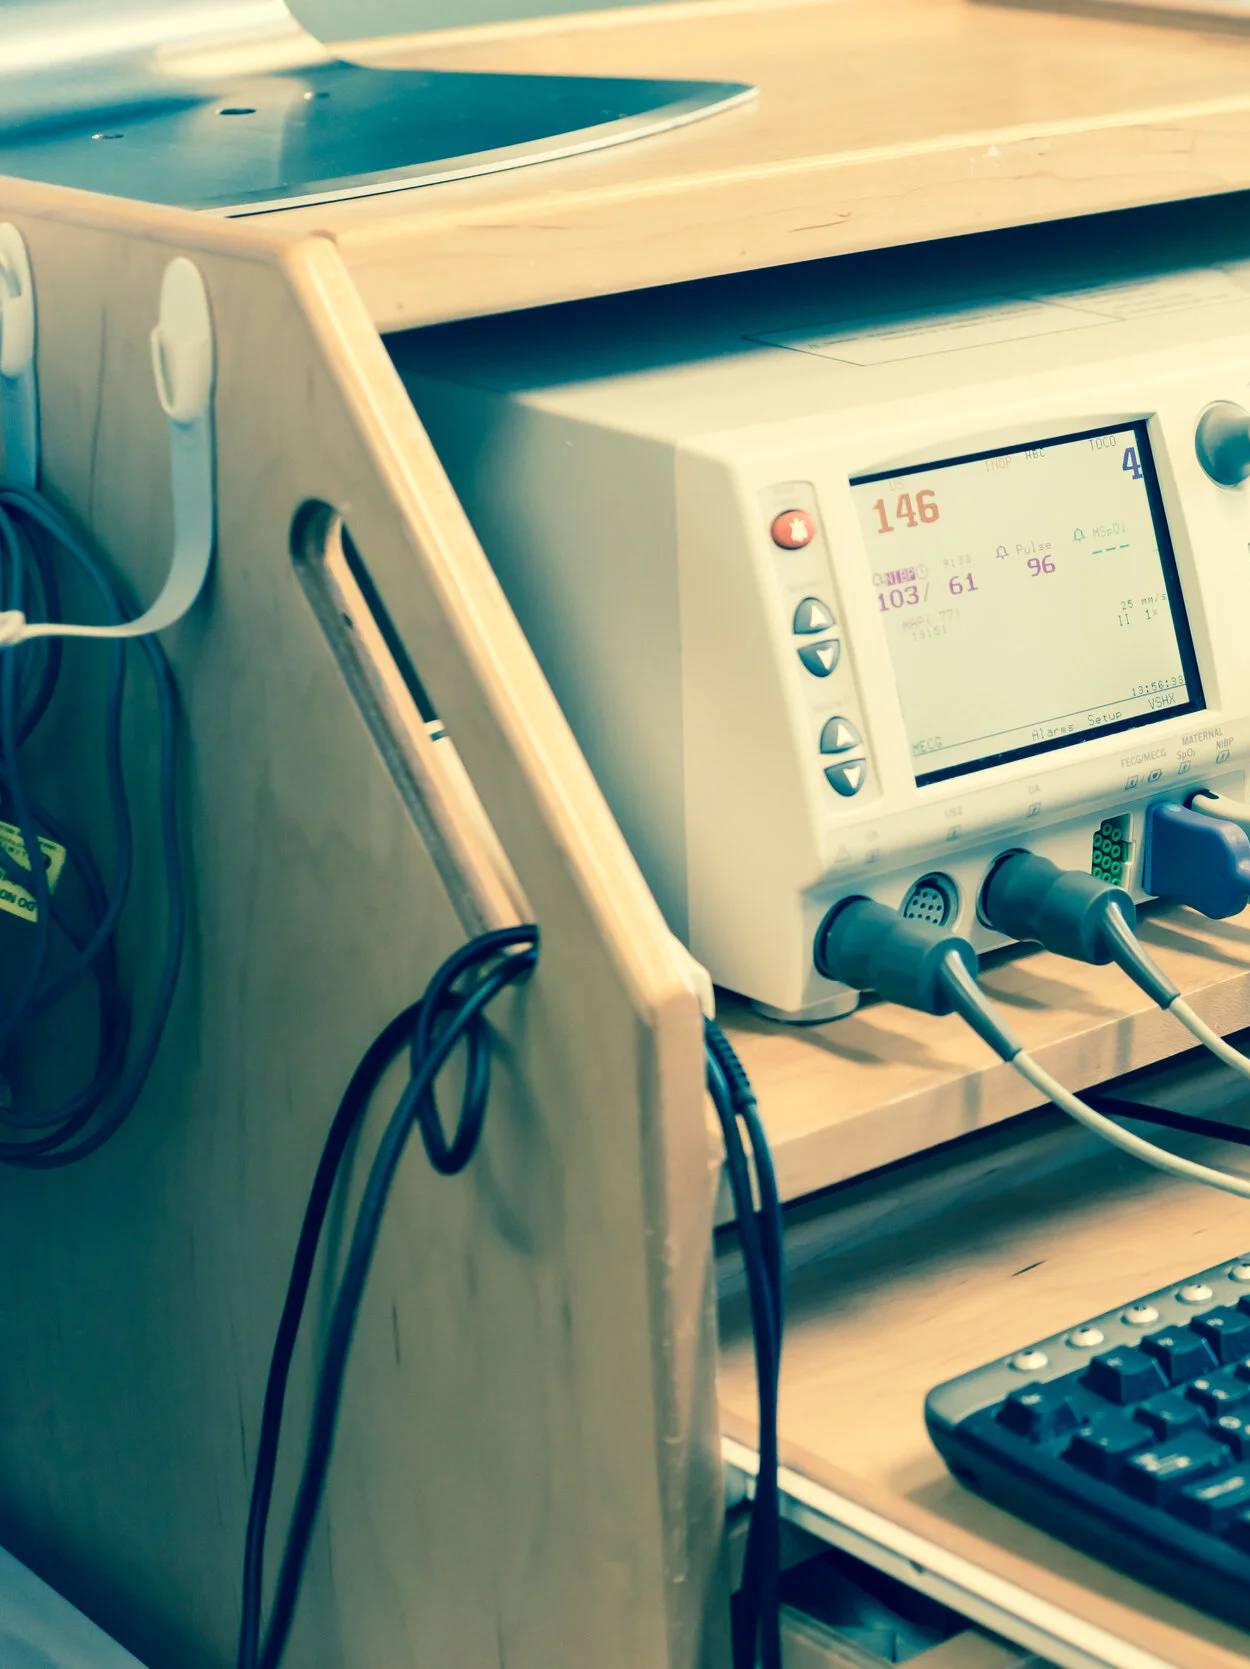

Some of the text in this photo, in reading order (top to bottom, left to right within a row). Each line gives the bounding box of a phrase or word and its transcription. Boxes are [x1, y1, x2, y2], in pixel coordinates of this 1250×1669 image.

[1088, 434, 1117, 451] TOCO
[984, 456, 1013, 473] INOP
[1122, 446, 1143, 480] 4
[872, 488, 940, 534] 146
[1015, 541, 1052, 556] Pulse
[1027, 554, 1056, 577] 96
[948, 572, 978, 595] 61
[1120, 599, 1134, 611] 25
[1131, 674, 1184, 697] 13:56:33
[1031, 711, 1123, 742] Alarms Setup
[1181, 726, 1224, 747] MATERNAL
[1120, 747, 1167, 769] FECG/MECG
